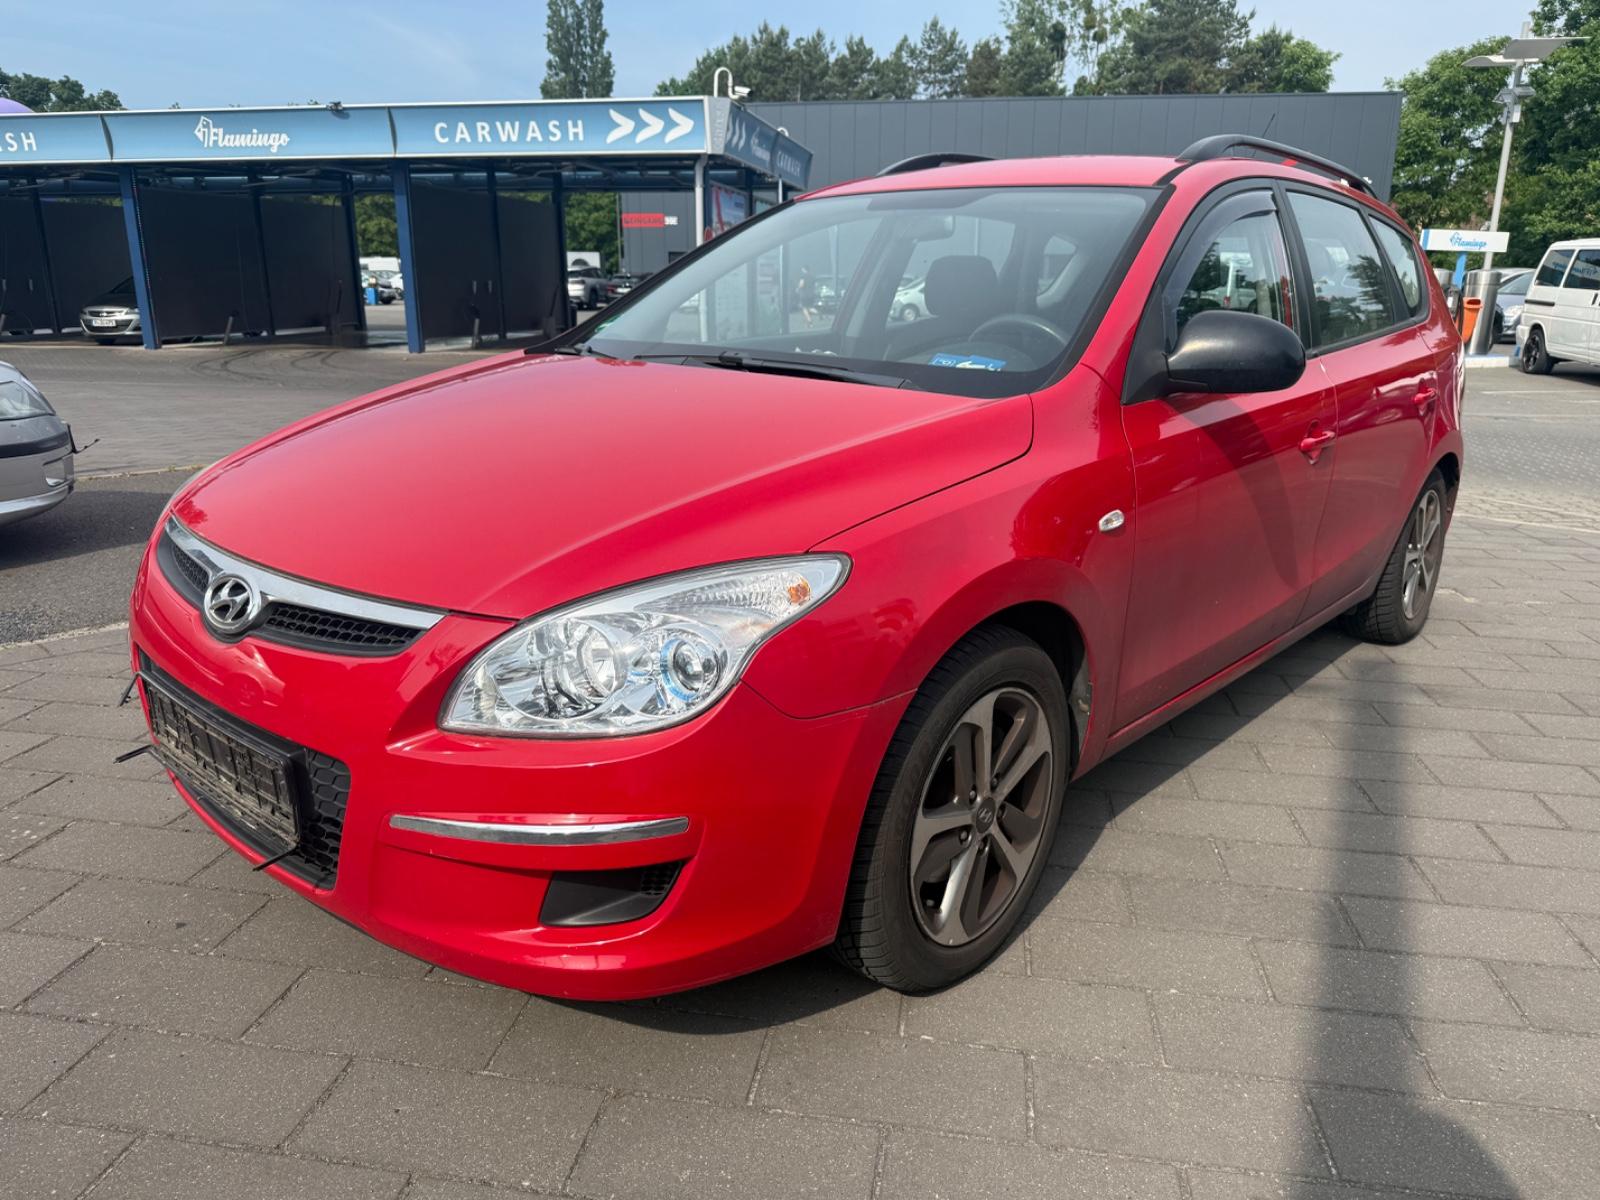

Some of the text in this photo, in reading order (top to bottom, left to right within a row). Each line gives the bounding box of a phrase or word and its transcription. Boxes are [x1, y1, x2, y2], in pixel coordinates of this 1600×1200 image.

[0, 132, 37, 152] SH
[209, 127, 290, 153] Flamingo
[434, 120, 584, 143] CARWASH
